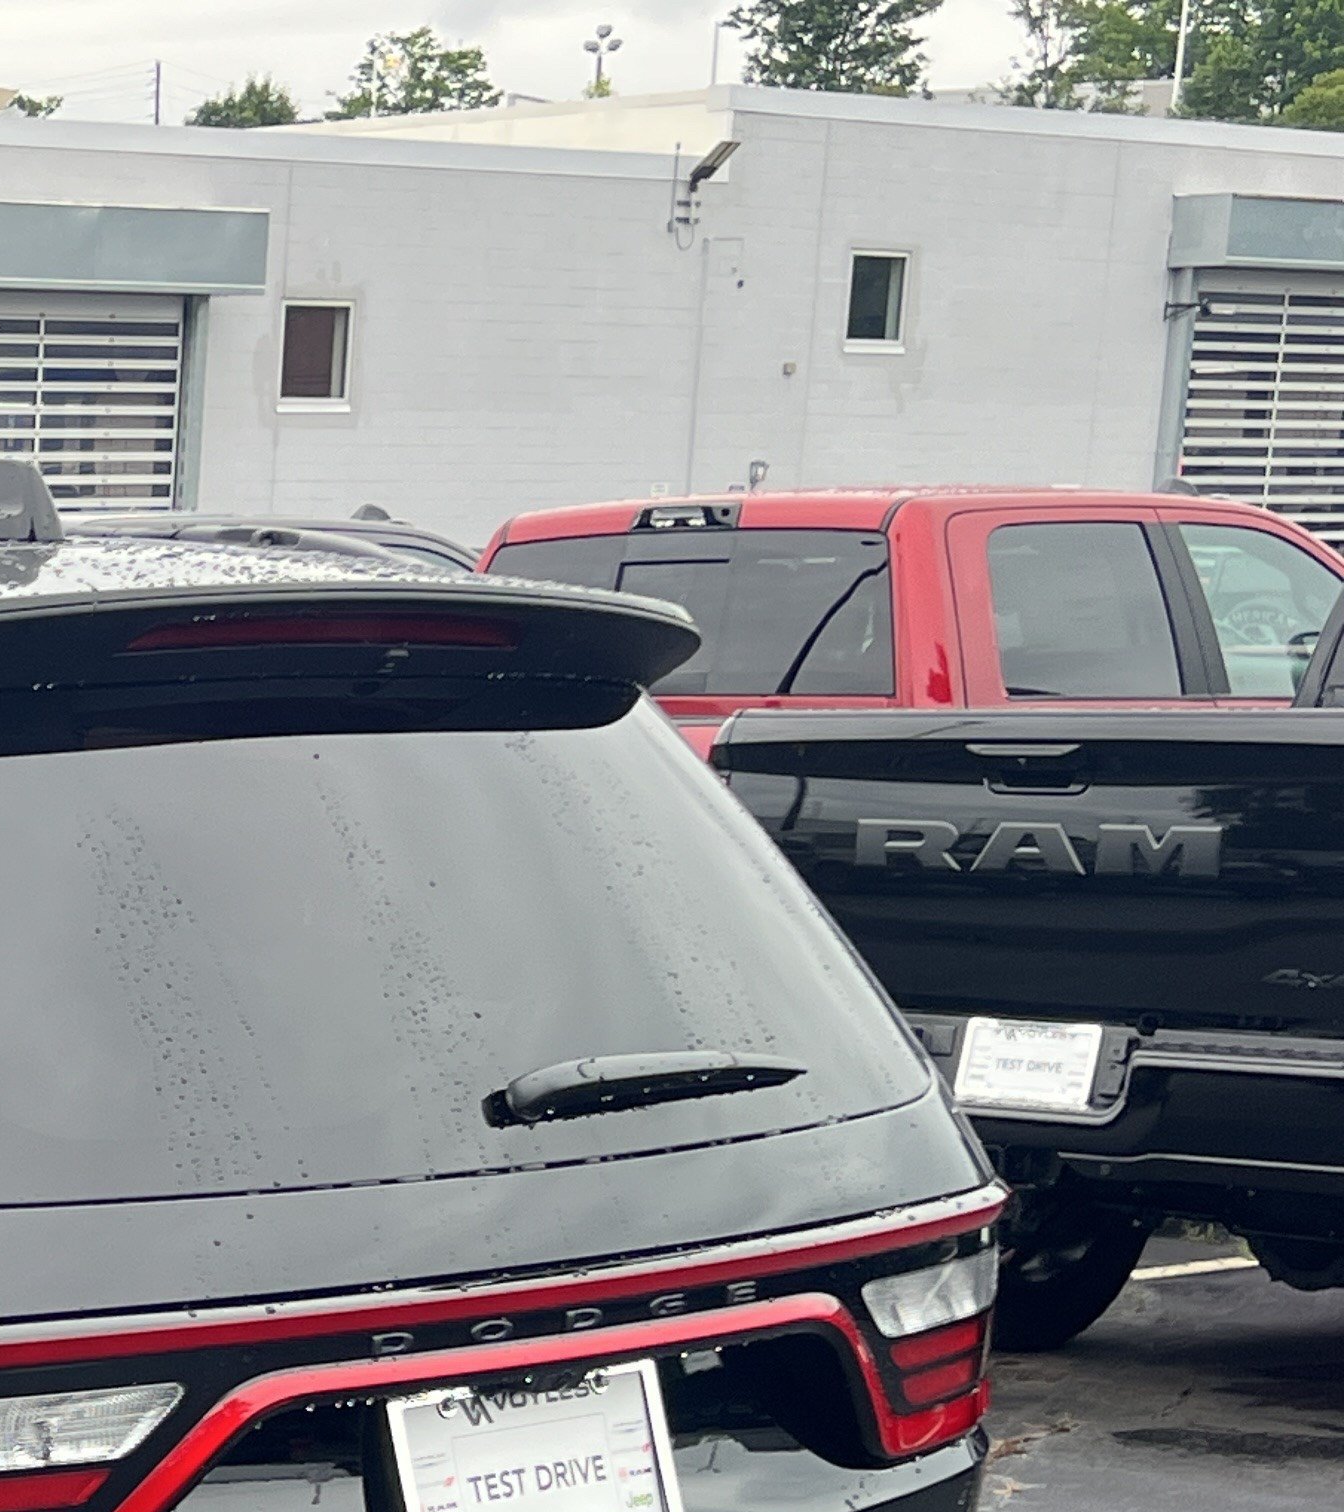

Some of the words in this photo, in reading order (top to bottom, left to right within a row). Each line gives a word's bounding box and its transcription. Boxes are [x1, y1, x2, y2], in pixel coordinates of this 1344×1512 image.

[855, 817, 1224, 878] RAM
[371, 1280, 758, 1354] DODGE
[467, 1468, 526, 1503] TEST
[535, 1454, 607, 1491] DRIVE
[625, 1490, 654, 1510] Jeep
